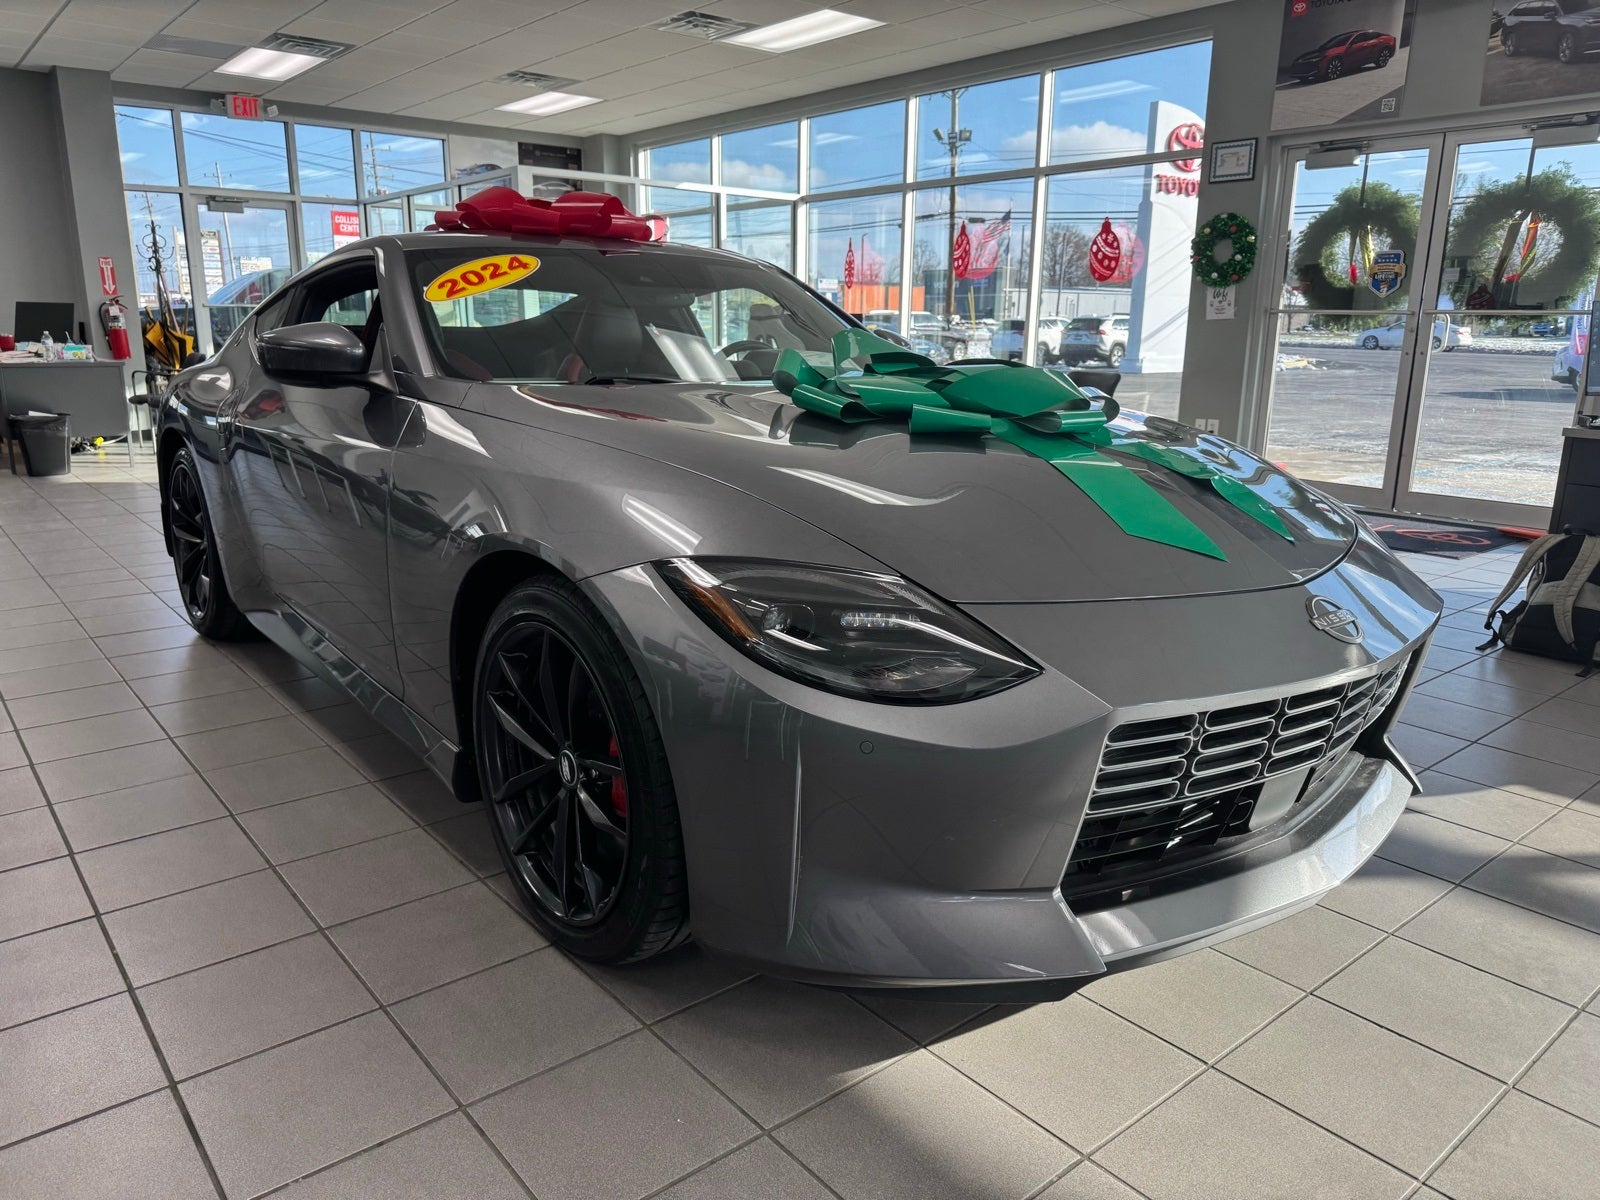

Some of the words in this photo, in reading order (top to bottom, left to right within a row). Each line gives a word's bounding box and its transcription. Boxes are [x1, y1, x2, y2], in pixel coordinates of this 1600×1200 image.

[232, 95, 259, 118] EXIT
[1154, 174, 1200, 197] TOYO
[437, 255, 531, 299] 2024
